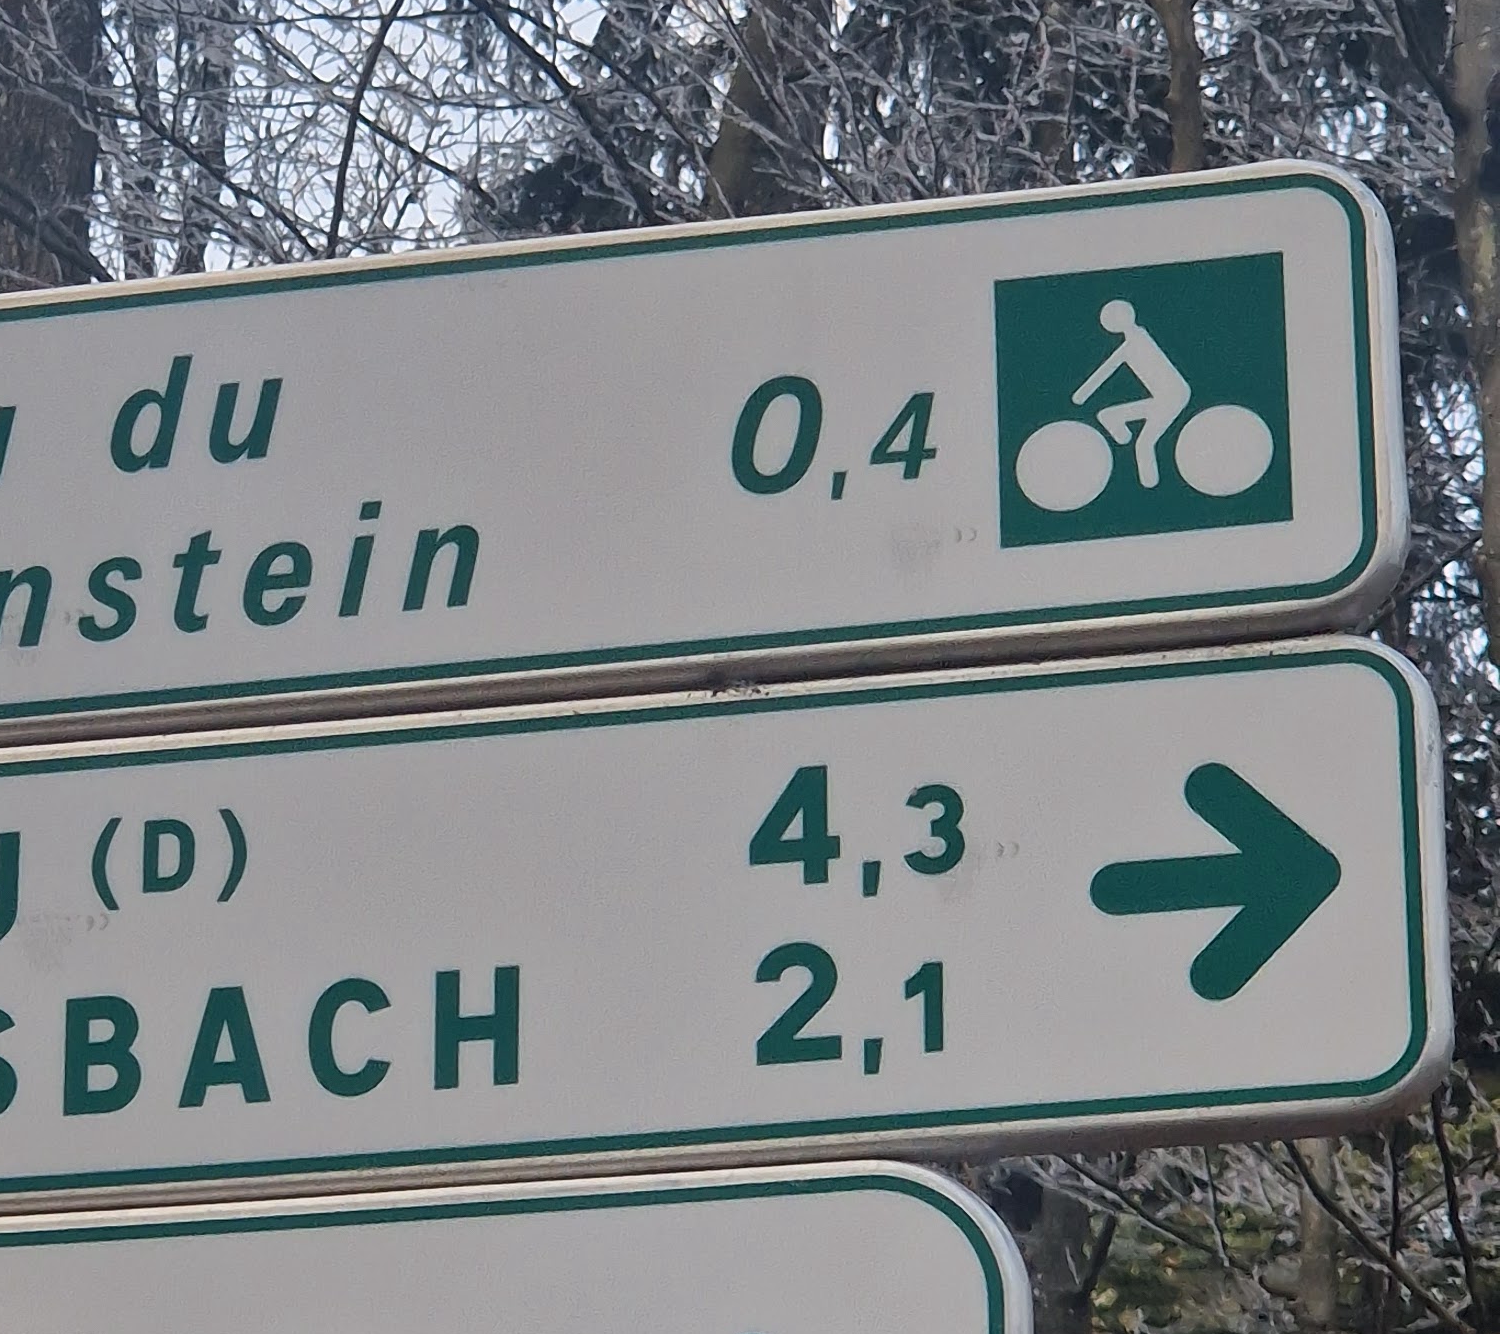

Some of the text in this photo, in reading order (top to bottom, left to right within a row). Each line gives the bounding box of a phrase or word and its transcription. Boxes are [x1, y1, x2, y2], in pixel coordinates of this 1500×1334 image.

[108, 355, 284, 475] du
[730, 375, 938, 500] 0,4
[90, 809, 251, 912] (D)
[748, 764, 968, 898] 4,3
[755, 942, 947, 1076] 2,1
